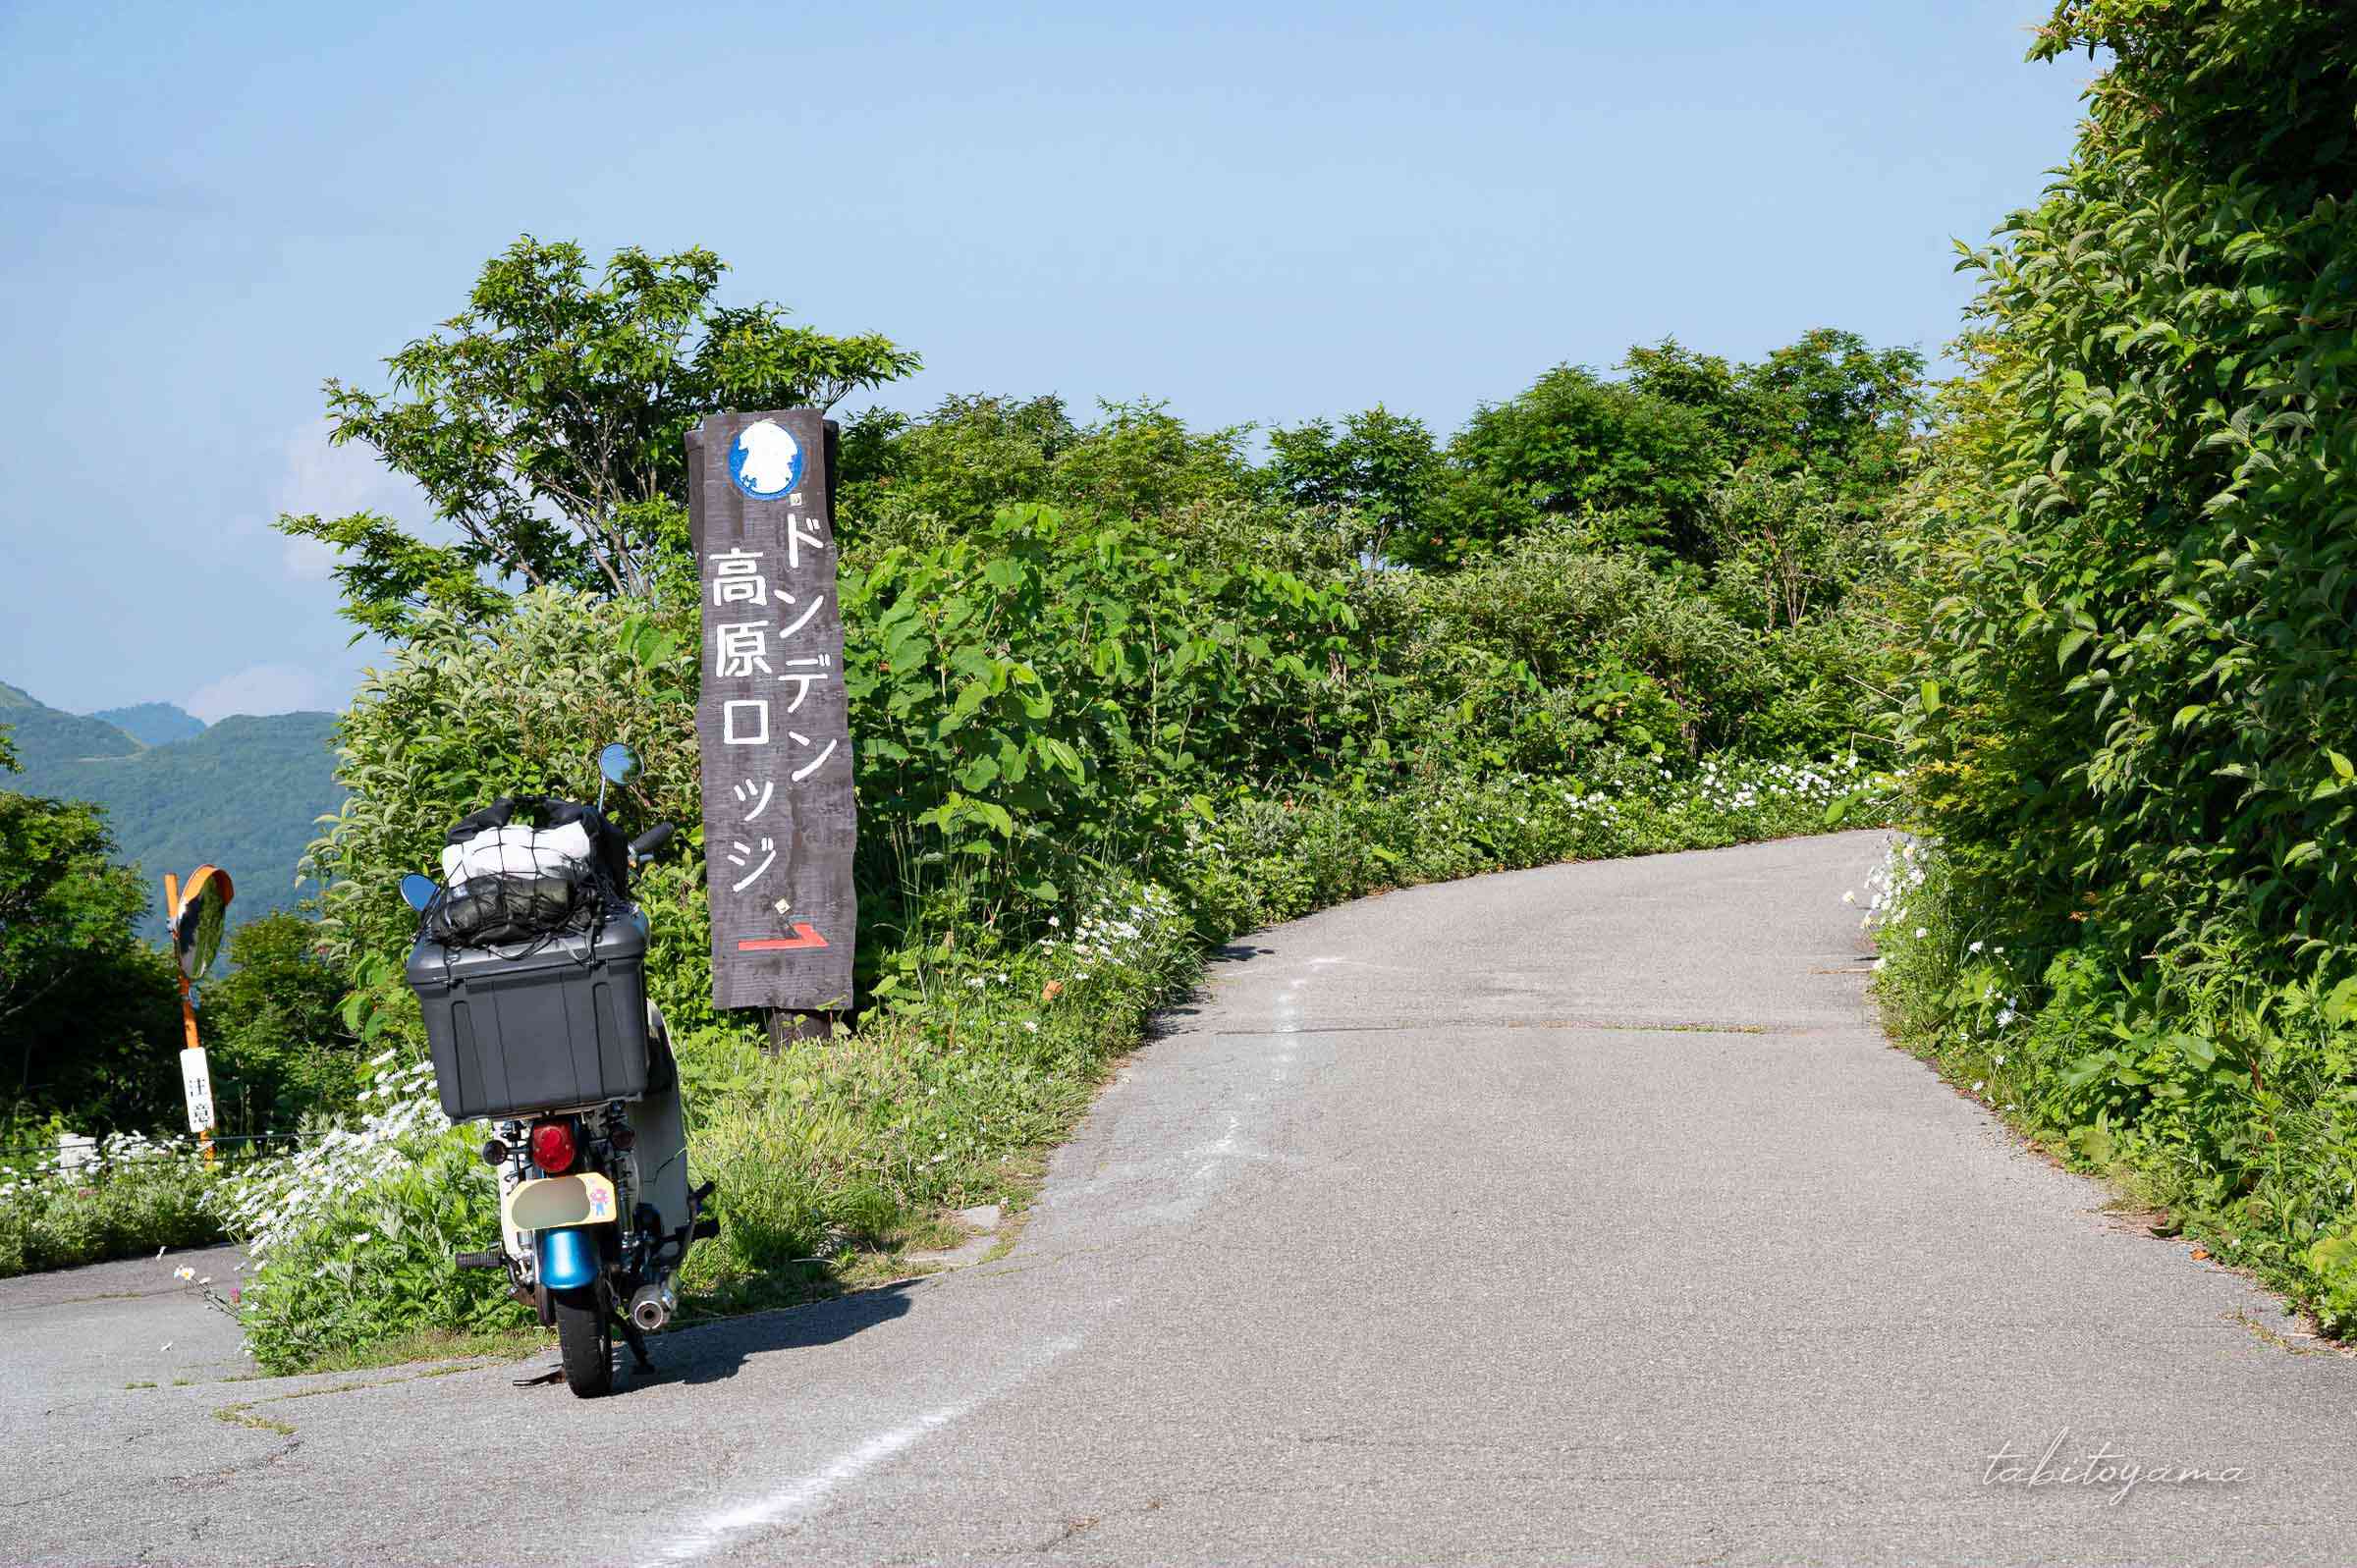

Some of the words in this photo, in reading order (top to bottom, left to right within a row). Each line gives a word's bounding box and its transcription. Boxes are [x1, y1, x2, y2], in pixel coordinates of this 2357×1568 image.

[709, 548, 777, 892] 高原ロッジ
[774, 514, 837, 782] ドンデン
